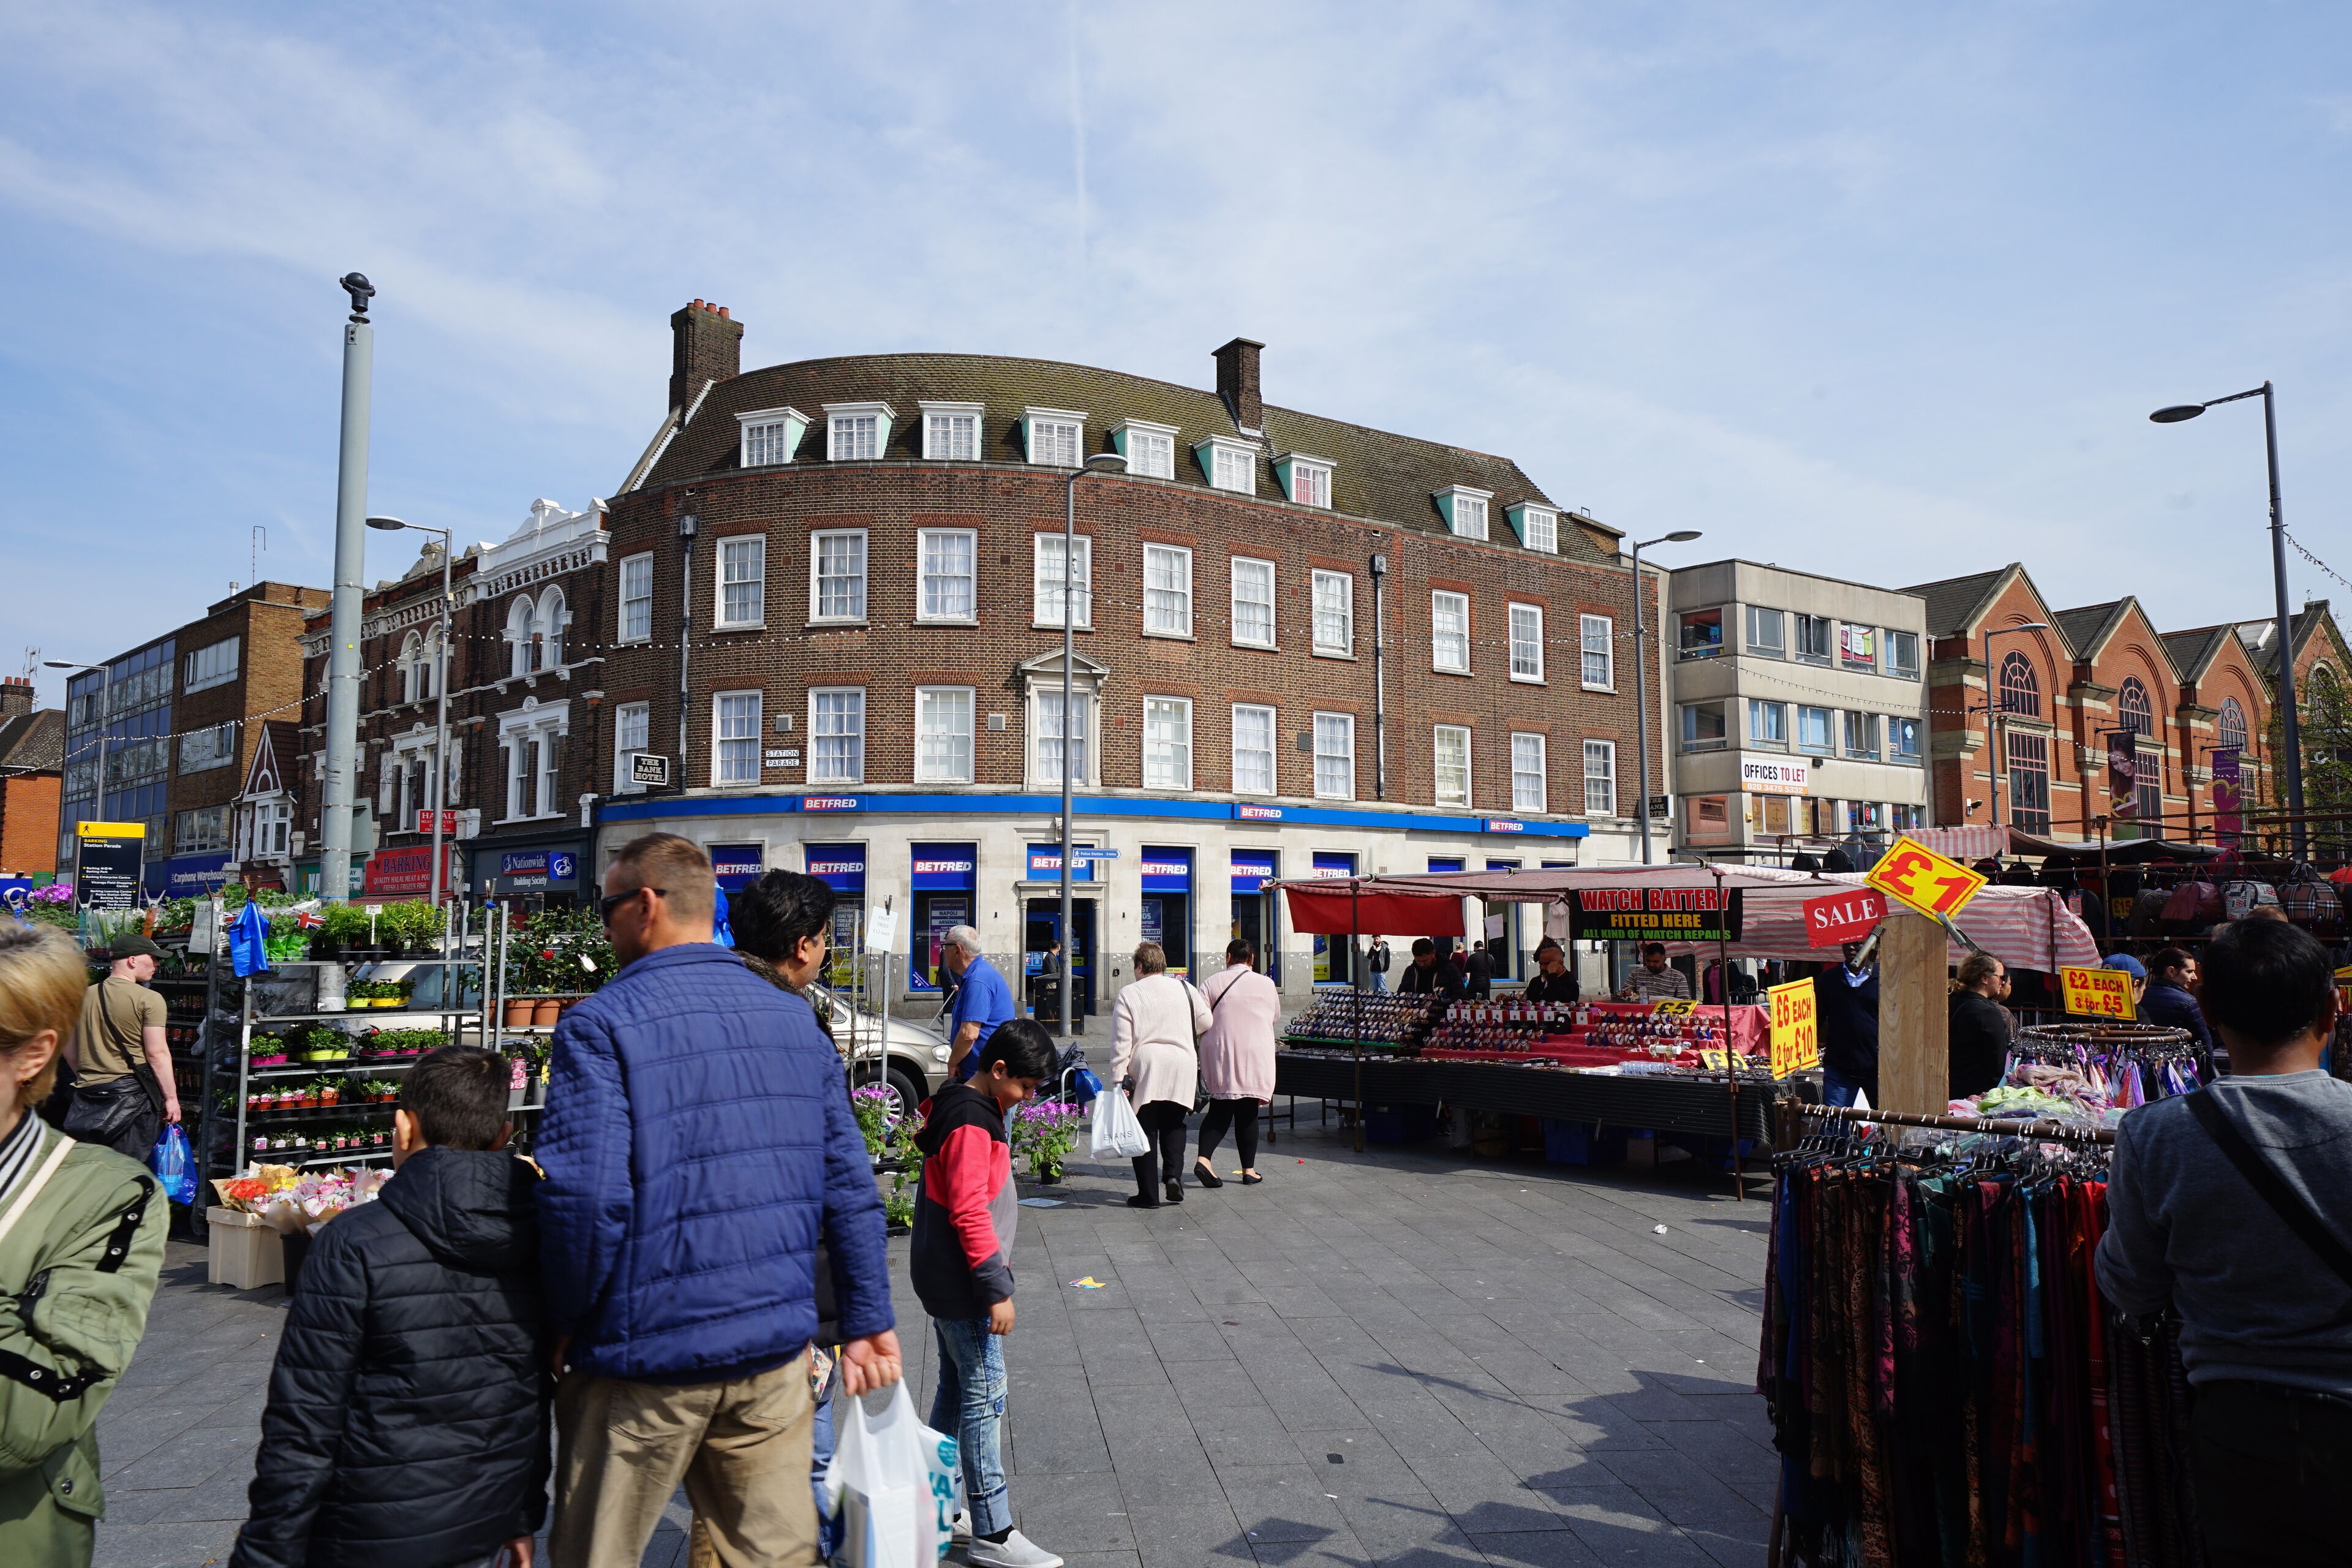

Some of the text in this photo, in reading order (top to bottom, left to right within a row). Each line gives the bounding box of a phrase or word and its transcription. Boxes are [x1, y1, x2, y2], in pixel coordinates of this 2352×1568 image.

[641, 758, 659, 766] THE
[637, 765, 662, 774] BANK
[1744, 764, 1805, 782] OFFICES TO LET
[635, 772, 665, 782] HOTEL
[805, 799, 857, 808] BETFRED
[1242, 807, 1282, 818] BETFRED
[1490, 822, 1523, 831] BETFRED
[383, 854, 430, 874] BARKING
[512, 855, 546, 869] Nationwide
[810, 862, 864, 873] BETFRED
[916, 861, 972, 872] BETFRED
[1033, 858, 1087, 868] BETFED
[715, 864, 762, 874] BETFRED
[1142, 864, 1188, 875] BETFRED
[1231, 866, 1272, 876] BETFRED
[1313, 869, 1350, 878] BETFRED
[174, 870, 225, 884] Carphone Warehouse
[514, 876, 548, 887] Building Society
[1879, 851, 1973, 913] £1
[1579, 888, 1731, 911] WATCH BATTERY
[2114, 899, 2131, 914] £15
[1814, 898, 1879, 929] SALE
[1610, 914, 1702, 928] FITTED HERE
[1583, 929, 1599, 938] ALL
[1601, 929, 1626, 939] KIND
[1627, 929, 1640, 939] OF
[1642, 930, 1682, 940] WATCH
[2069, 971, 2124, 993] £2 EACH
[1657, 1002, 1692, 1016] £5
[2075, 993, 2124, 1014] 3 for £5
[1776, 993, 1811, 1028] £6 EACH
[1777, 1025, 1813, 1066] 2 for £10
[1708, 1051, 1744, 1069] £5
[1103, 1130, 1133, 1141] EVANS
